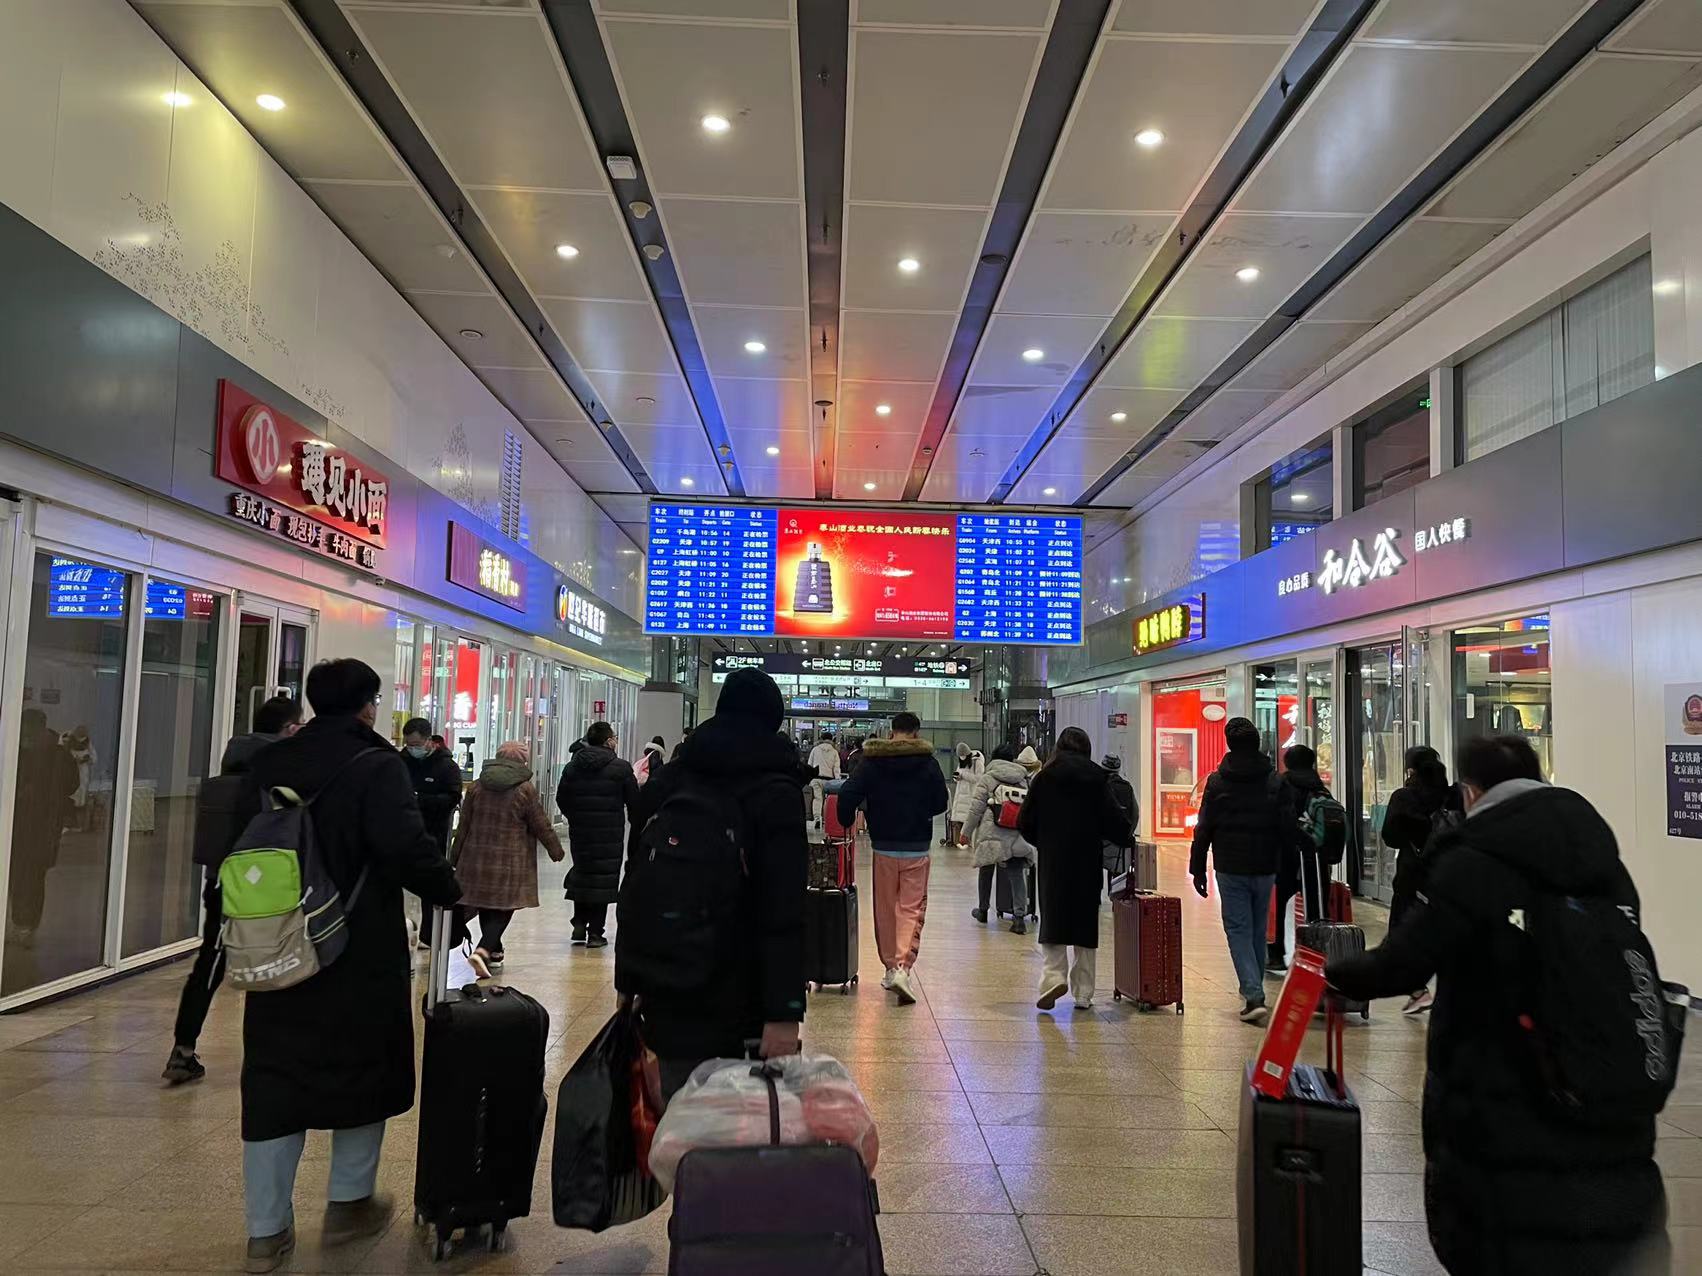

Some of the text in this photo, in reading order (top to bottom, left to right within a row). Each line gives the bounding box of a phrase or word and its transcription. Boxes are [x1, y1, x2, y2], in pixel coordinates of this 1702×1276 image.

[235, 493, 281, 532] 重庆小面
[301, 442, 386, 535] 遇见小面
[1278, 571, 1309, 596] 良心品质
[1317, 527, 1402, 595] 和合谷
[1414, 518, 1465, 551] 国人快餐
